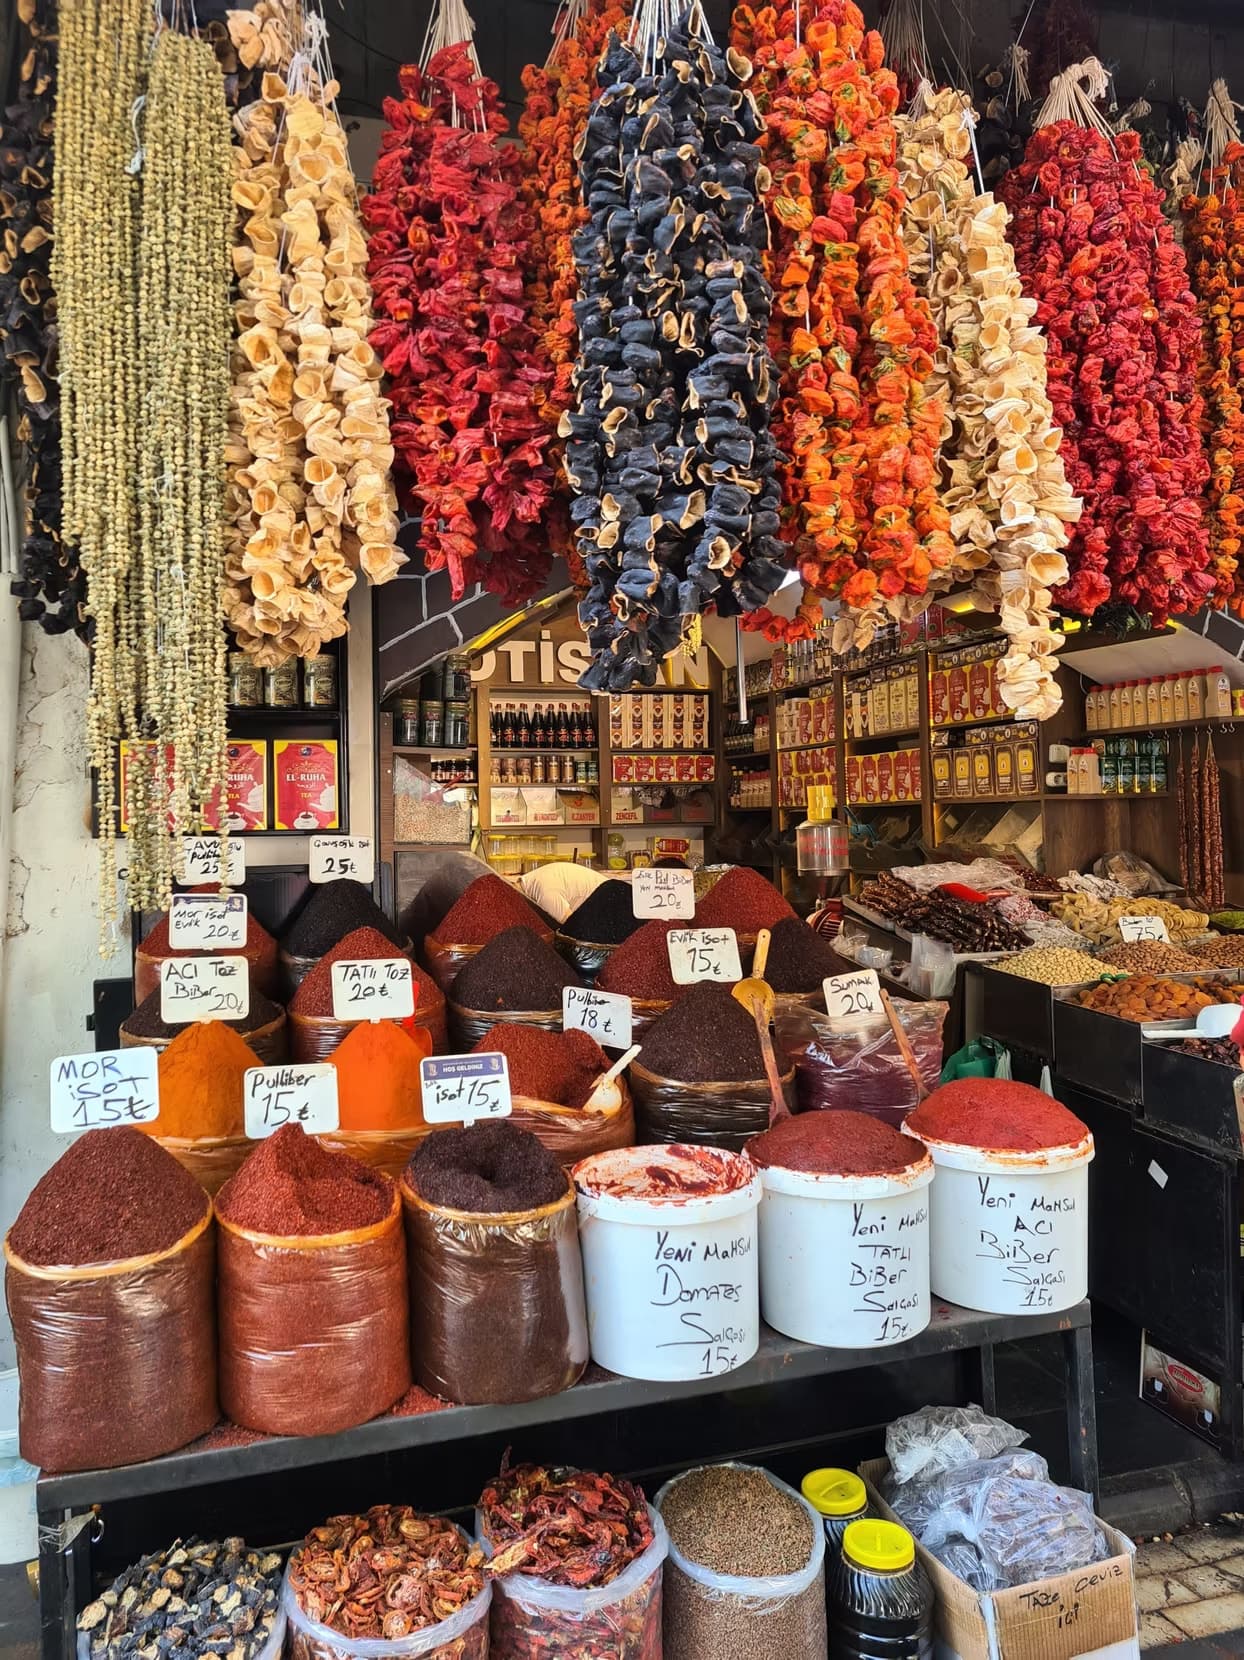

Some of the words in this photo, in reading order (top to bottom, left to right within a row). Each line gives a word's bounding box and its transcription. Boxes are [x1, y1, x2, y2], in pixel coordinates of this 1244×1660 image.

[286, 773, 326, 781] EL-RUHA
[57, 1056, 122, 1083] MOR
[978, 1175, 1016, 1209] Yeni
[852, 1202, 887, 1237] Yeni
[1013, 1215, 1053, 1236] ACI
[655, 1231, 697, 1262] YeNi
